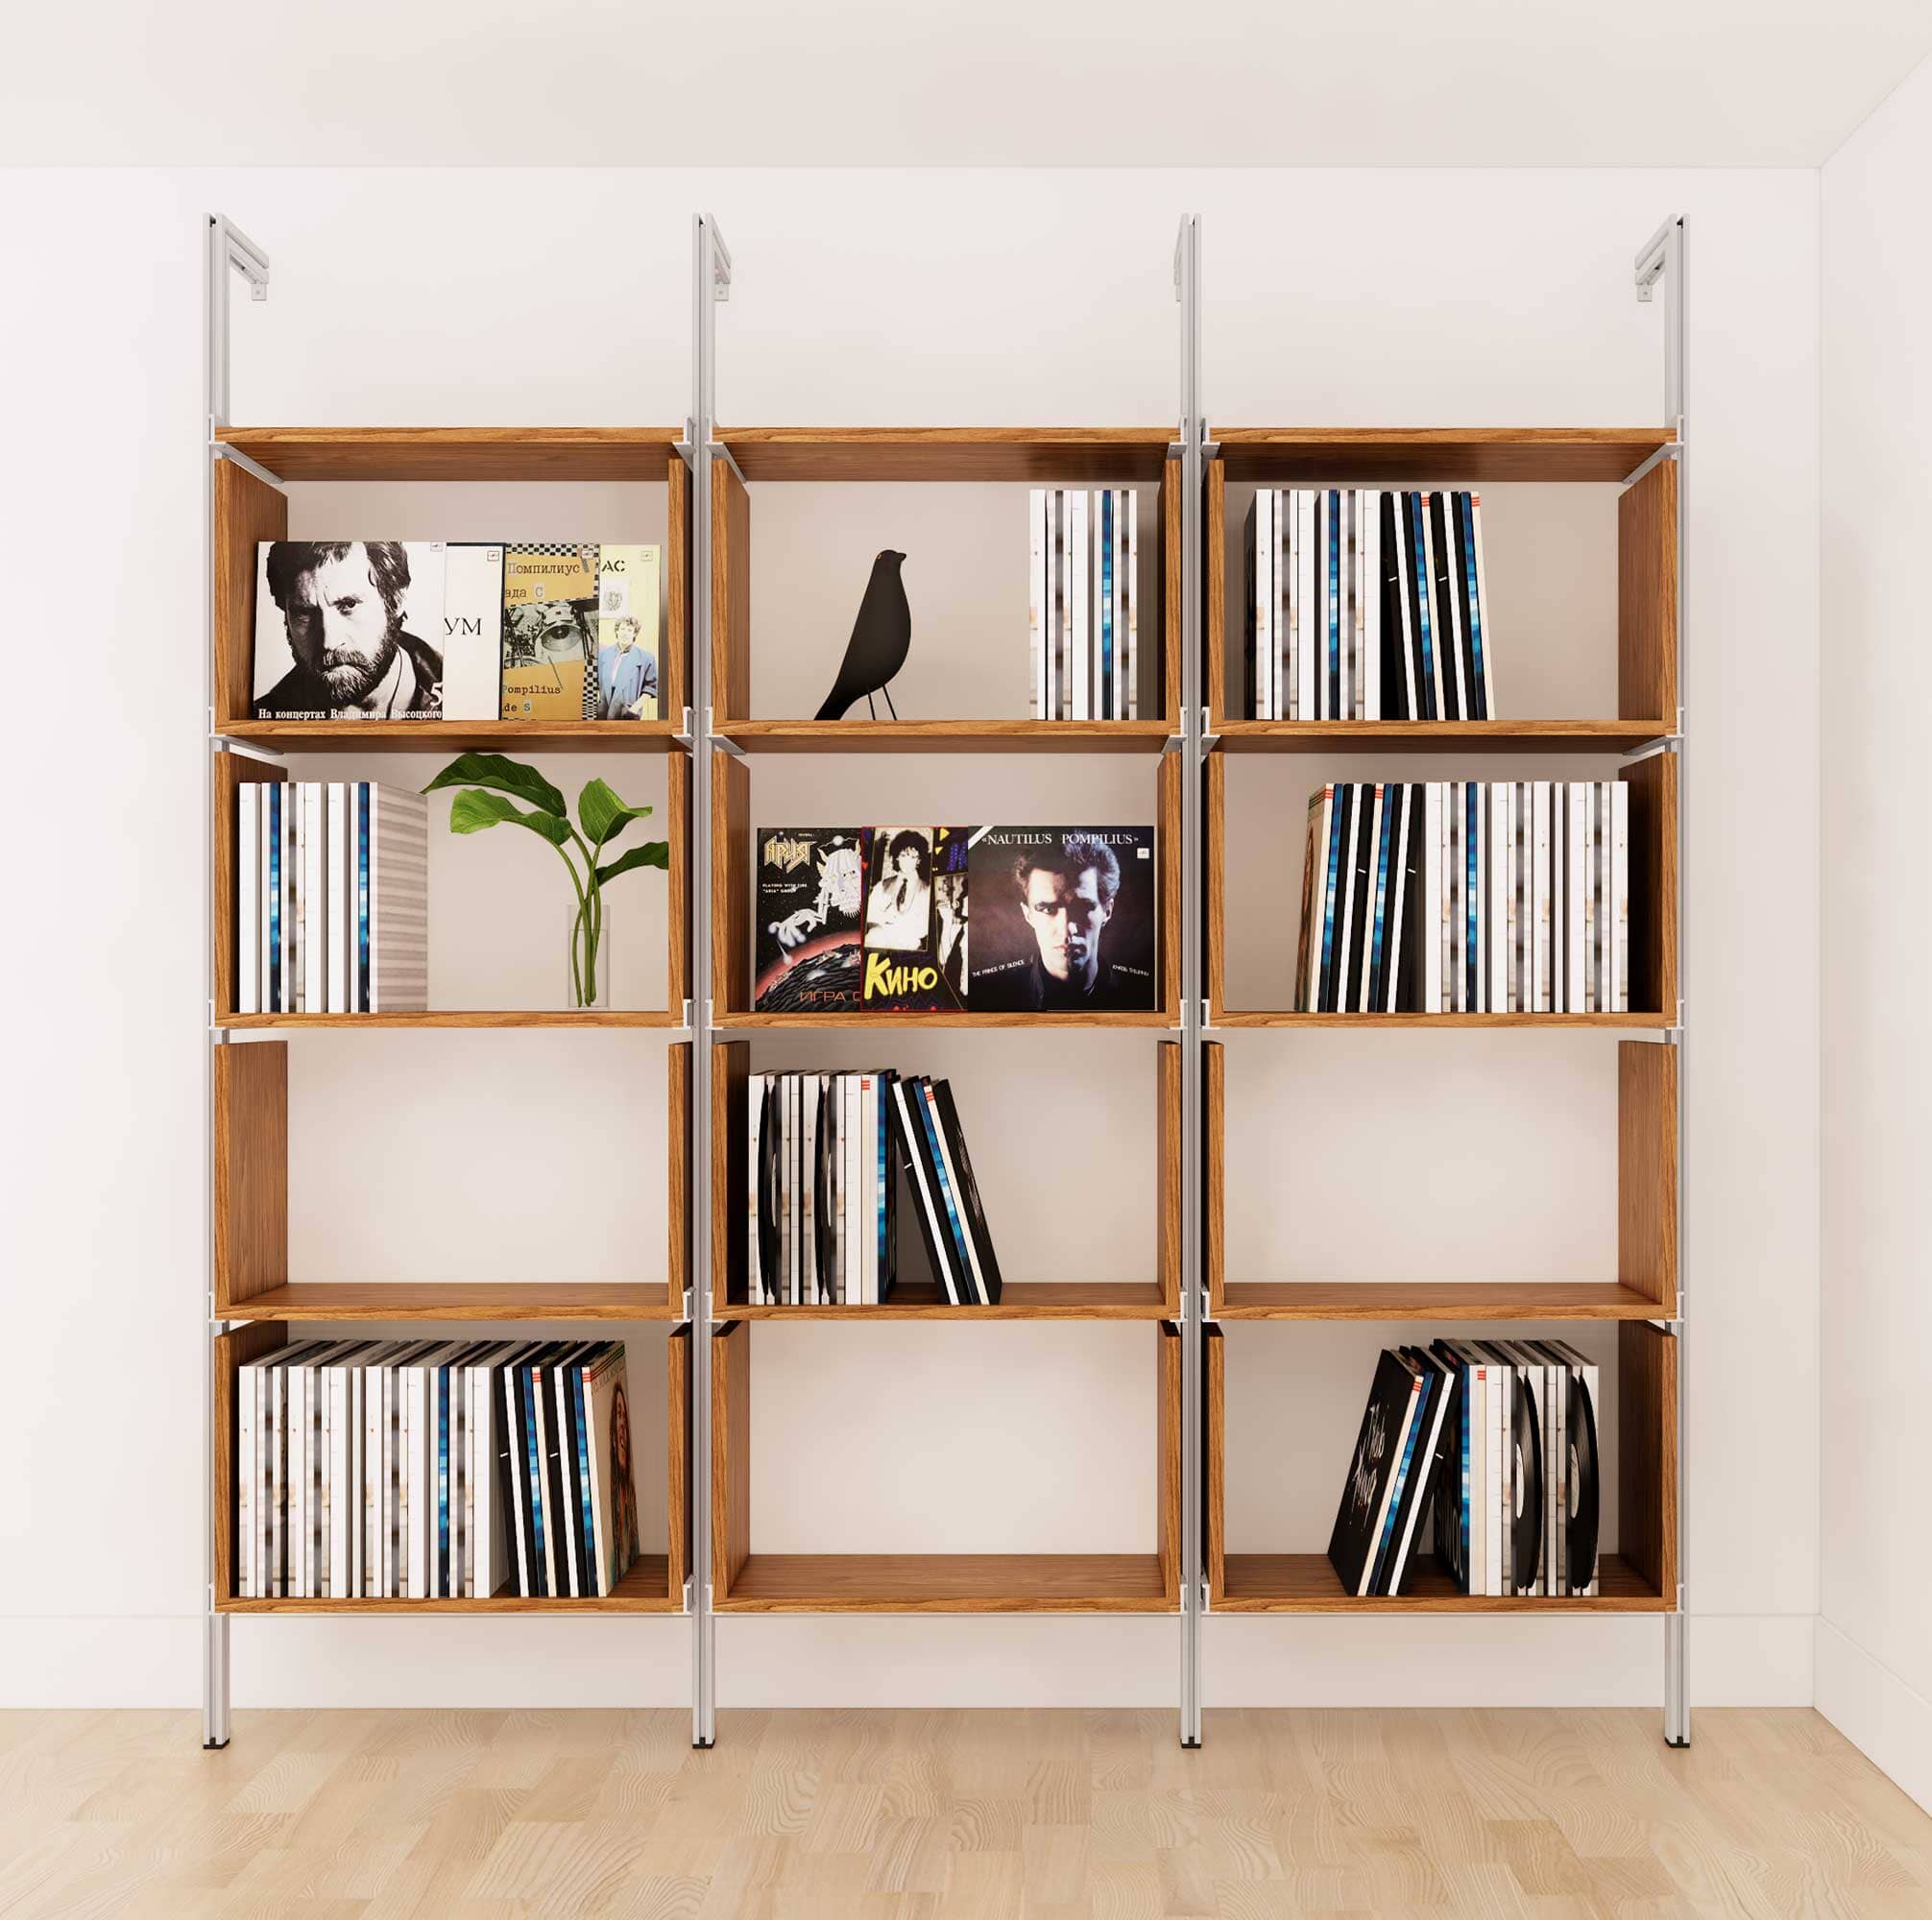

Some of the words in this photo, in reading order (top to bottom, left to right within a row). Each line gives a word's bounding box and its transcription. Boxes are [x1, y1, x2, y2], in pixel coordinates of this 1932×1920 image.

[444, 617, 482, 636] УМ
[430, 682, 443, 707] 5
[258, 708, 272, 719] На
[276, 709, 326, 720] концертах
[330, 708, 386, 720] Владимира
[800, 991, 846, 1001] ИГРА
